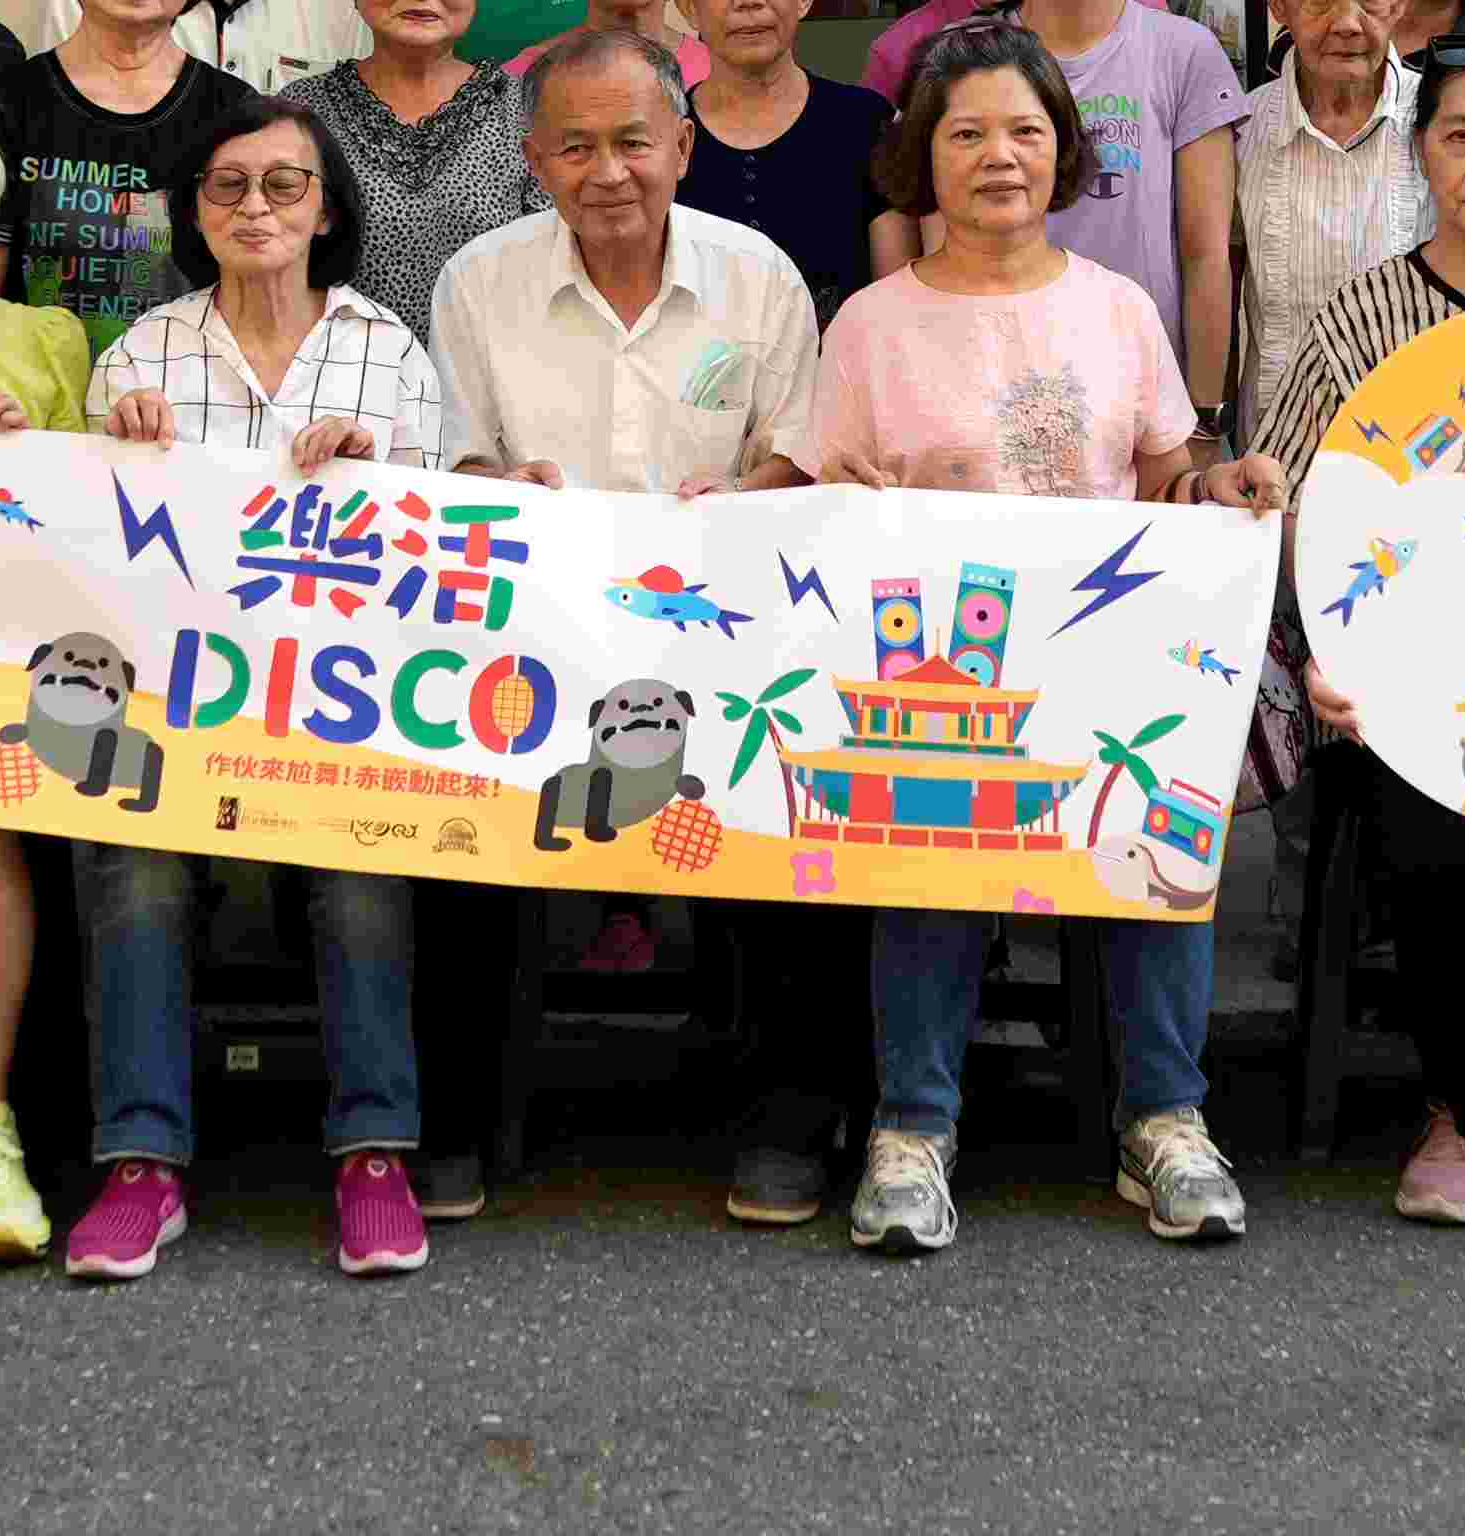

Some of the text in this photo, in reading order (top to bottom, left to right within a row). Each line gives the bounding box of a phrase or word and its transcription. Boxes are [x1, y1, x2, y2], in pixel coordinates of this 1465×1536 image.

[20, 156, 150, 189] SUMMER
[226, 483, 530, 632] 樂活
[166, 628, 558, 756] DISCO
